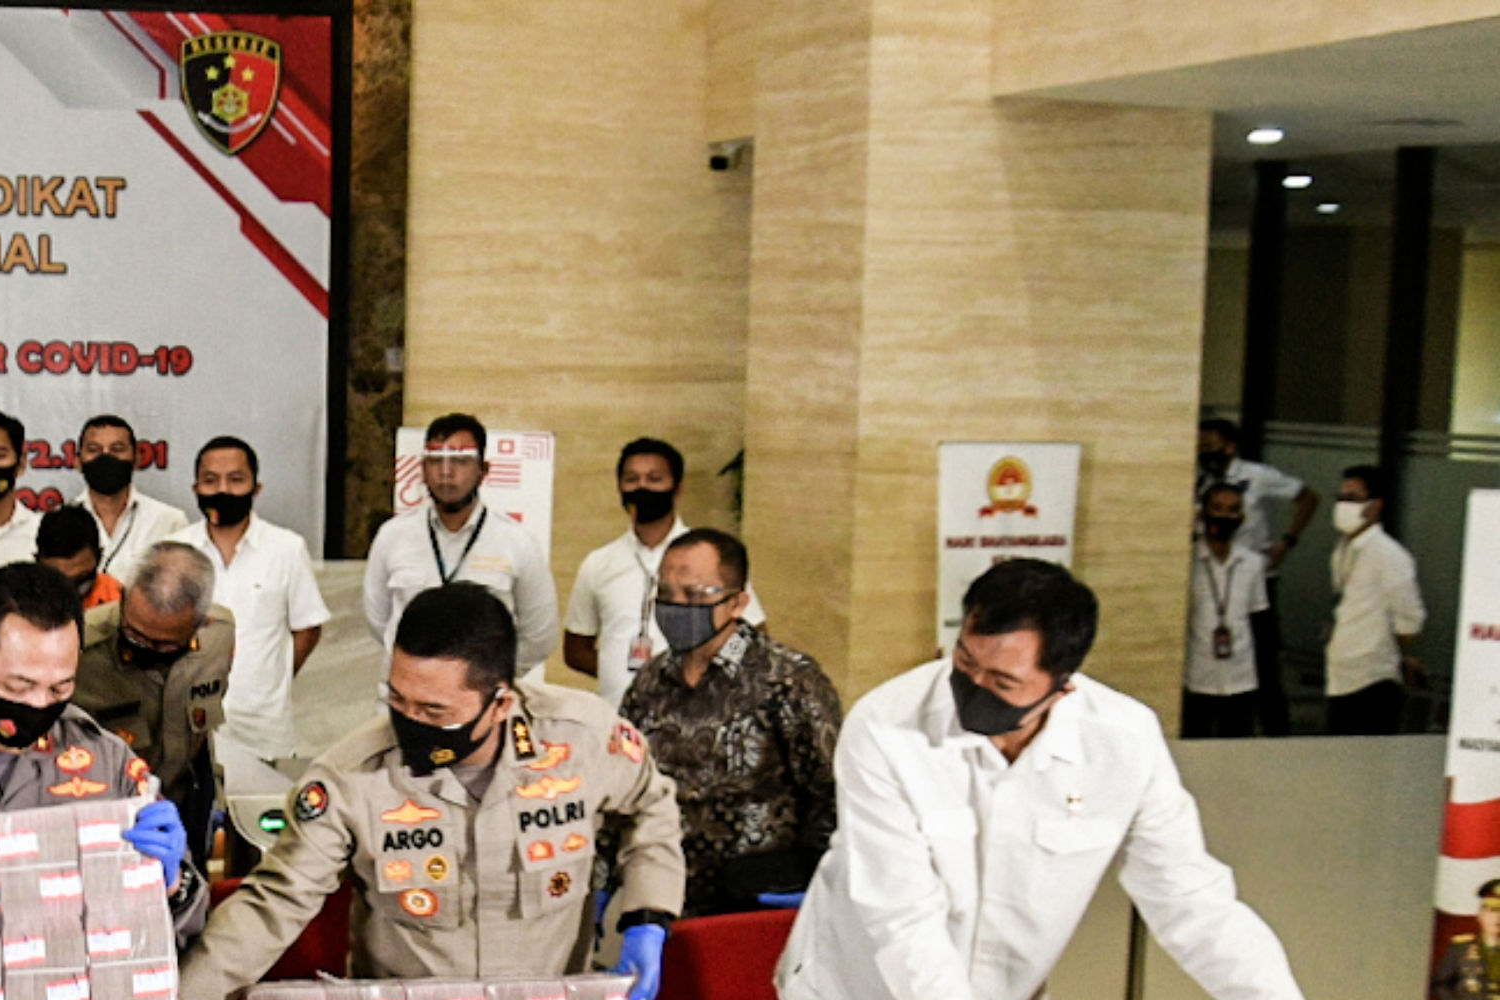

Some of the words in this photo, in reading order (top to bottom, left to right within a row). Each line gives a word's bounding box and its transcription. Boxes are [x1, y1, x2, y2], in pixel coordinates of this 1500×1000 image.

[16, 340, 194, 376] COVID-19
[518, 801, 585, 833] POLRI
[383, 828, 443, 853] ARGO
